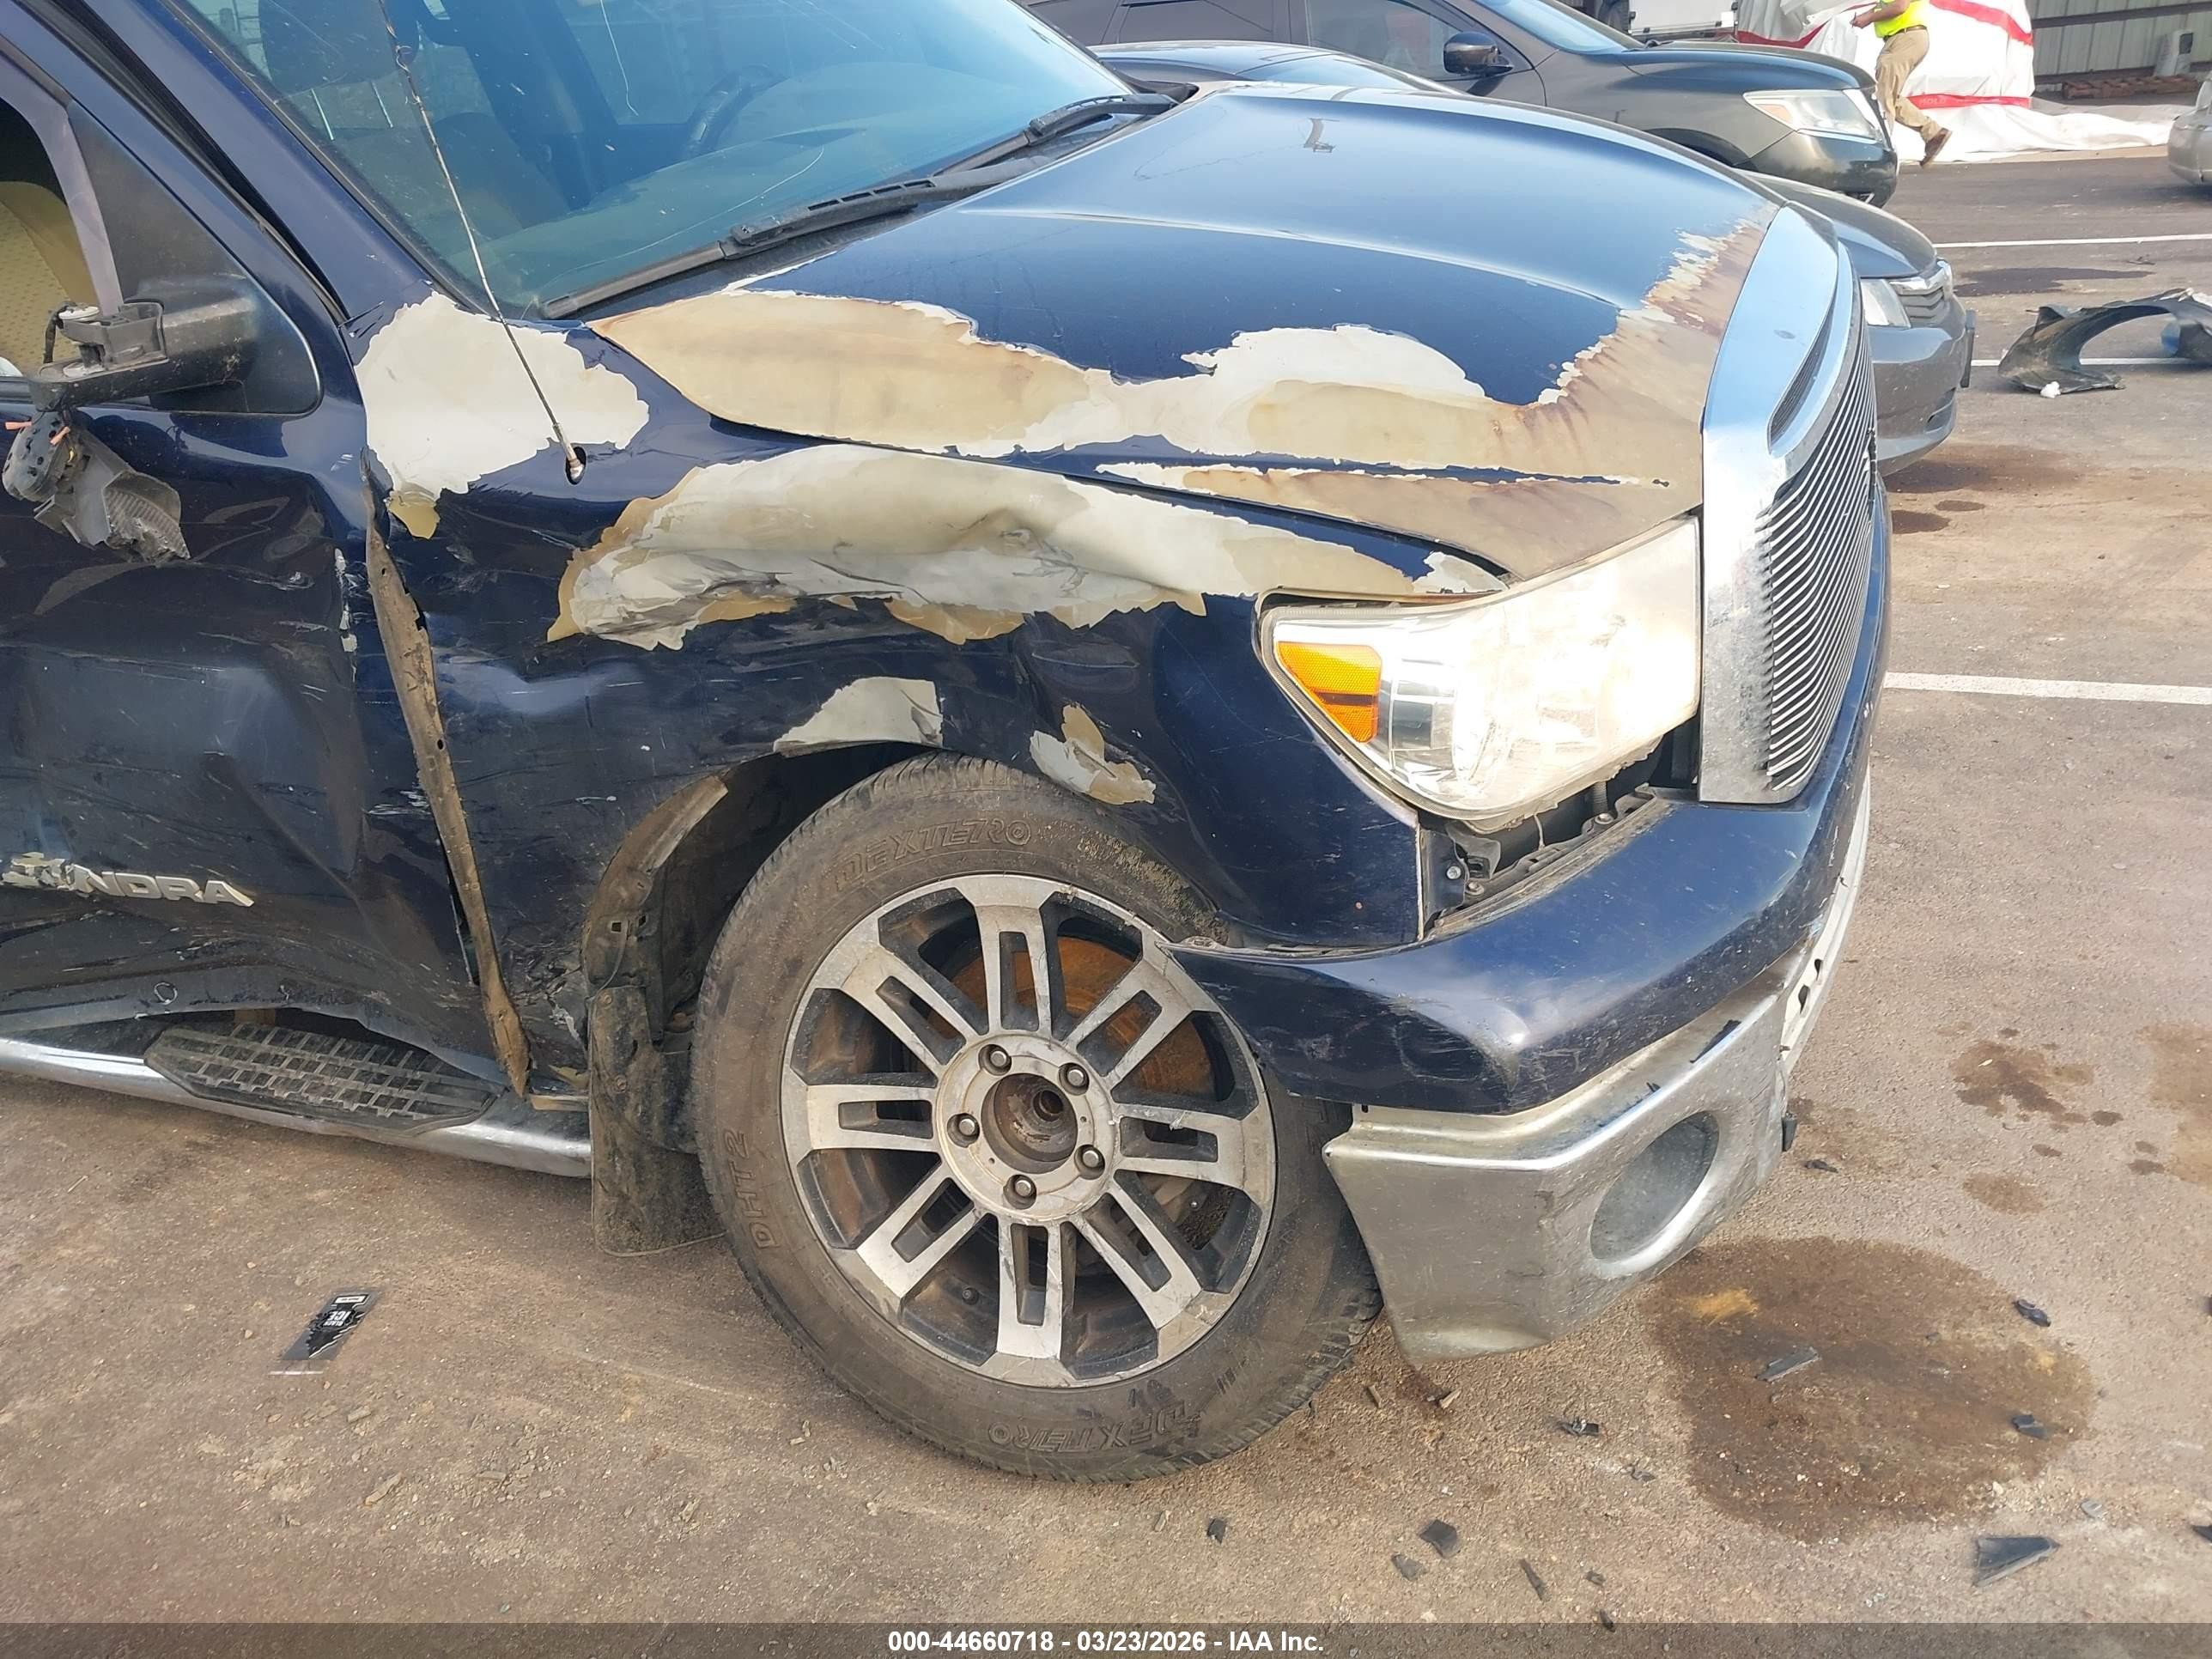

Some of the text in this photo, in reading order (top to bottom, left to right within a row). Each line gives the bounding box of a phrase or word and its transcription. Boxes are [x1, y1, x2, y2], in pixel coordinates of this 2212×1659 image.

[1, 852, 255, 907] NDRA
[833, 817, 1032, 890] DEXTERO
[327, 1310, 352, 1321] ICE
